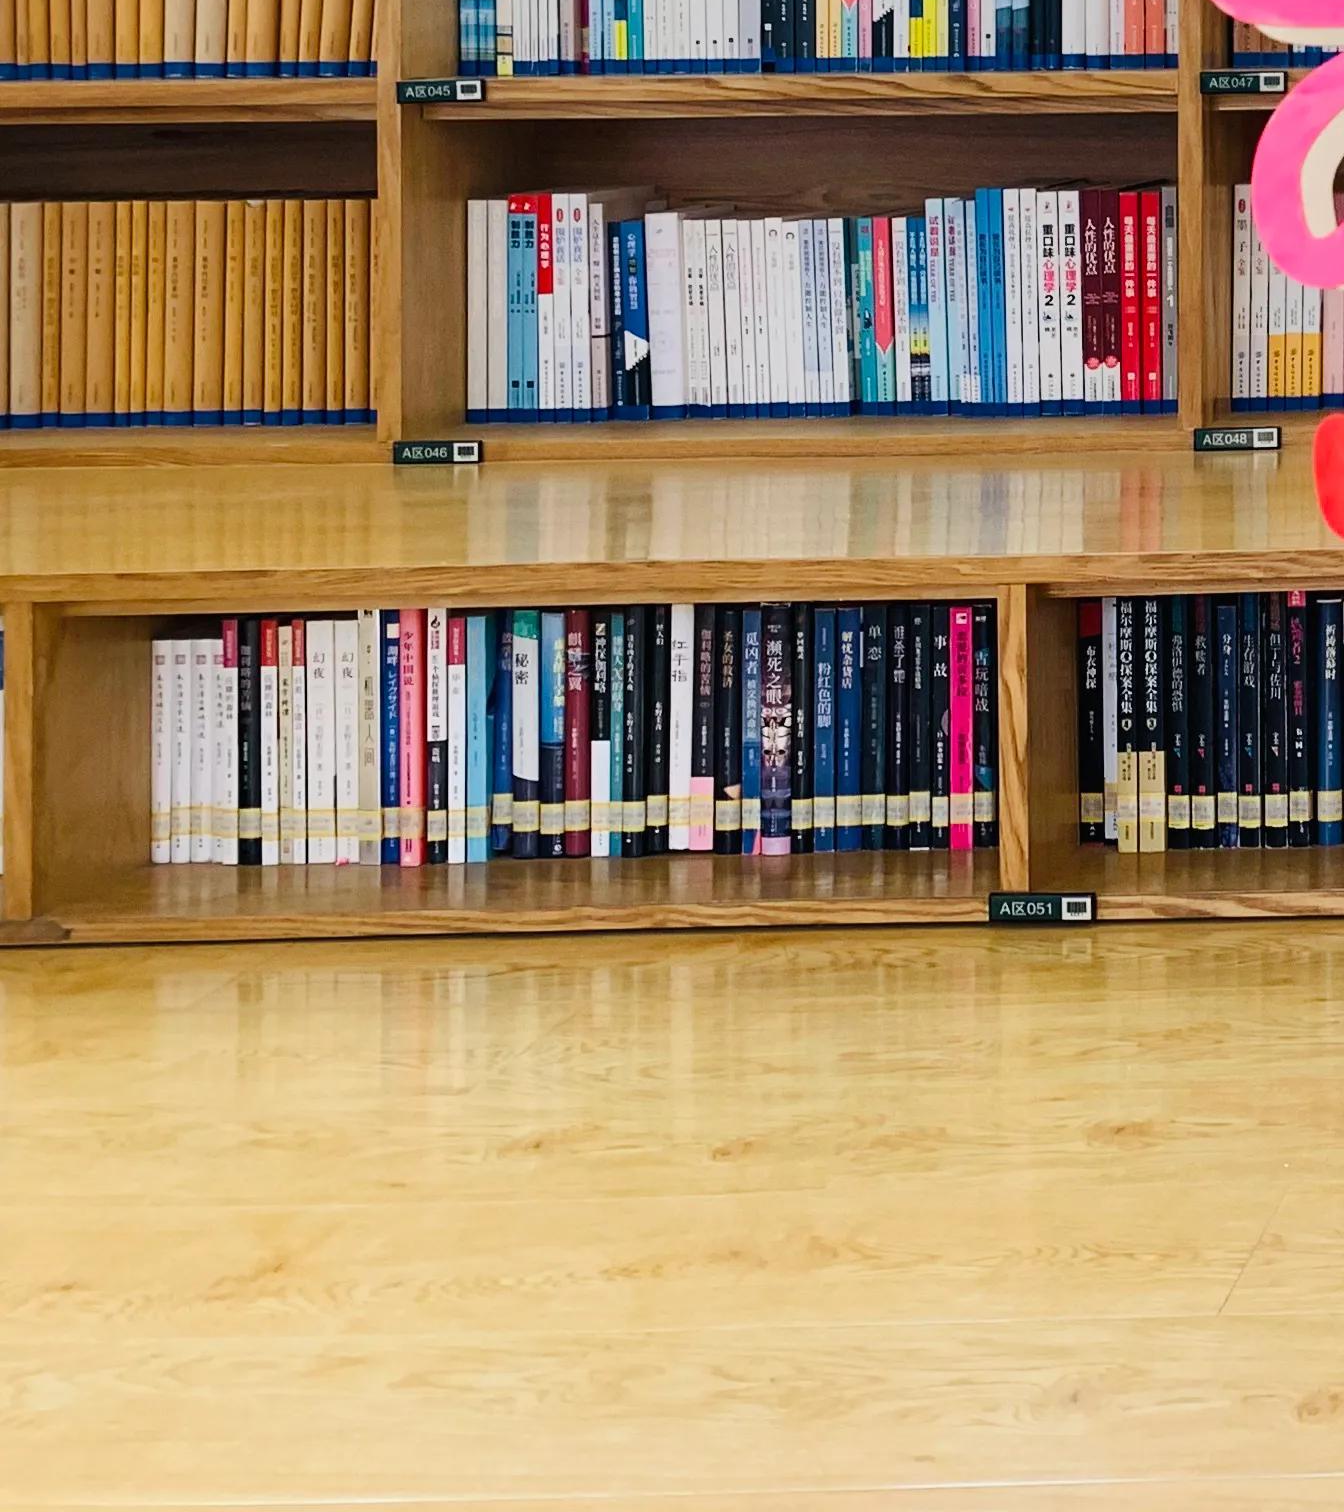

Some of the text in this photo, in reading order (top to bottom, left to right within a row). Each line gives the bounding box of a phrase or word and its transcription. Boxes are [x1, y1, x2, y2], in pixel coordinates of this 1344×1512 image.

[405, 85, 451, 98] A区045
[1209, 76, 1254, 89] A区047
[1085, 218, 1098, 276] 人性的优点
[1103, 217, 1116, 274] 人性的优点
[402, 446, 448, 458] A区046
[1202, 432, 1248, 445] A区048
[745, 632, 760, 675] 觅凶者
[868, 625, 883, 661] 单恋
[893, 625, 906, 684] 谁杀了她
[934, 635, 948, 678] 事故
[1223, 634, 1232, 656] 分身
[1243, 635, 1256, 688] 生存游戏
[312, 651, 325, 680] 幻夜
[341, 651, 354, 680] 幻夜
[515, 653, 529, 686] 秘密
[766, 640, 784, 705] 濒死之眼
[975, 651, 989, 712] 古玩暗战
[1270, 633, 1281, 700] 但丁与佐川
[817, 662, 831, 729] 粉红色的脚
[1000, 901, 1053, 916] A区051
